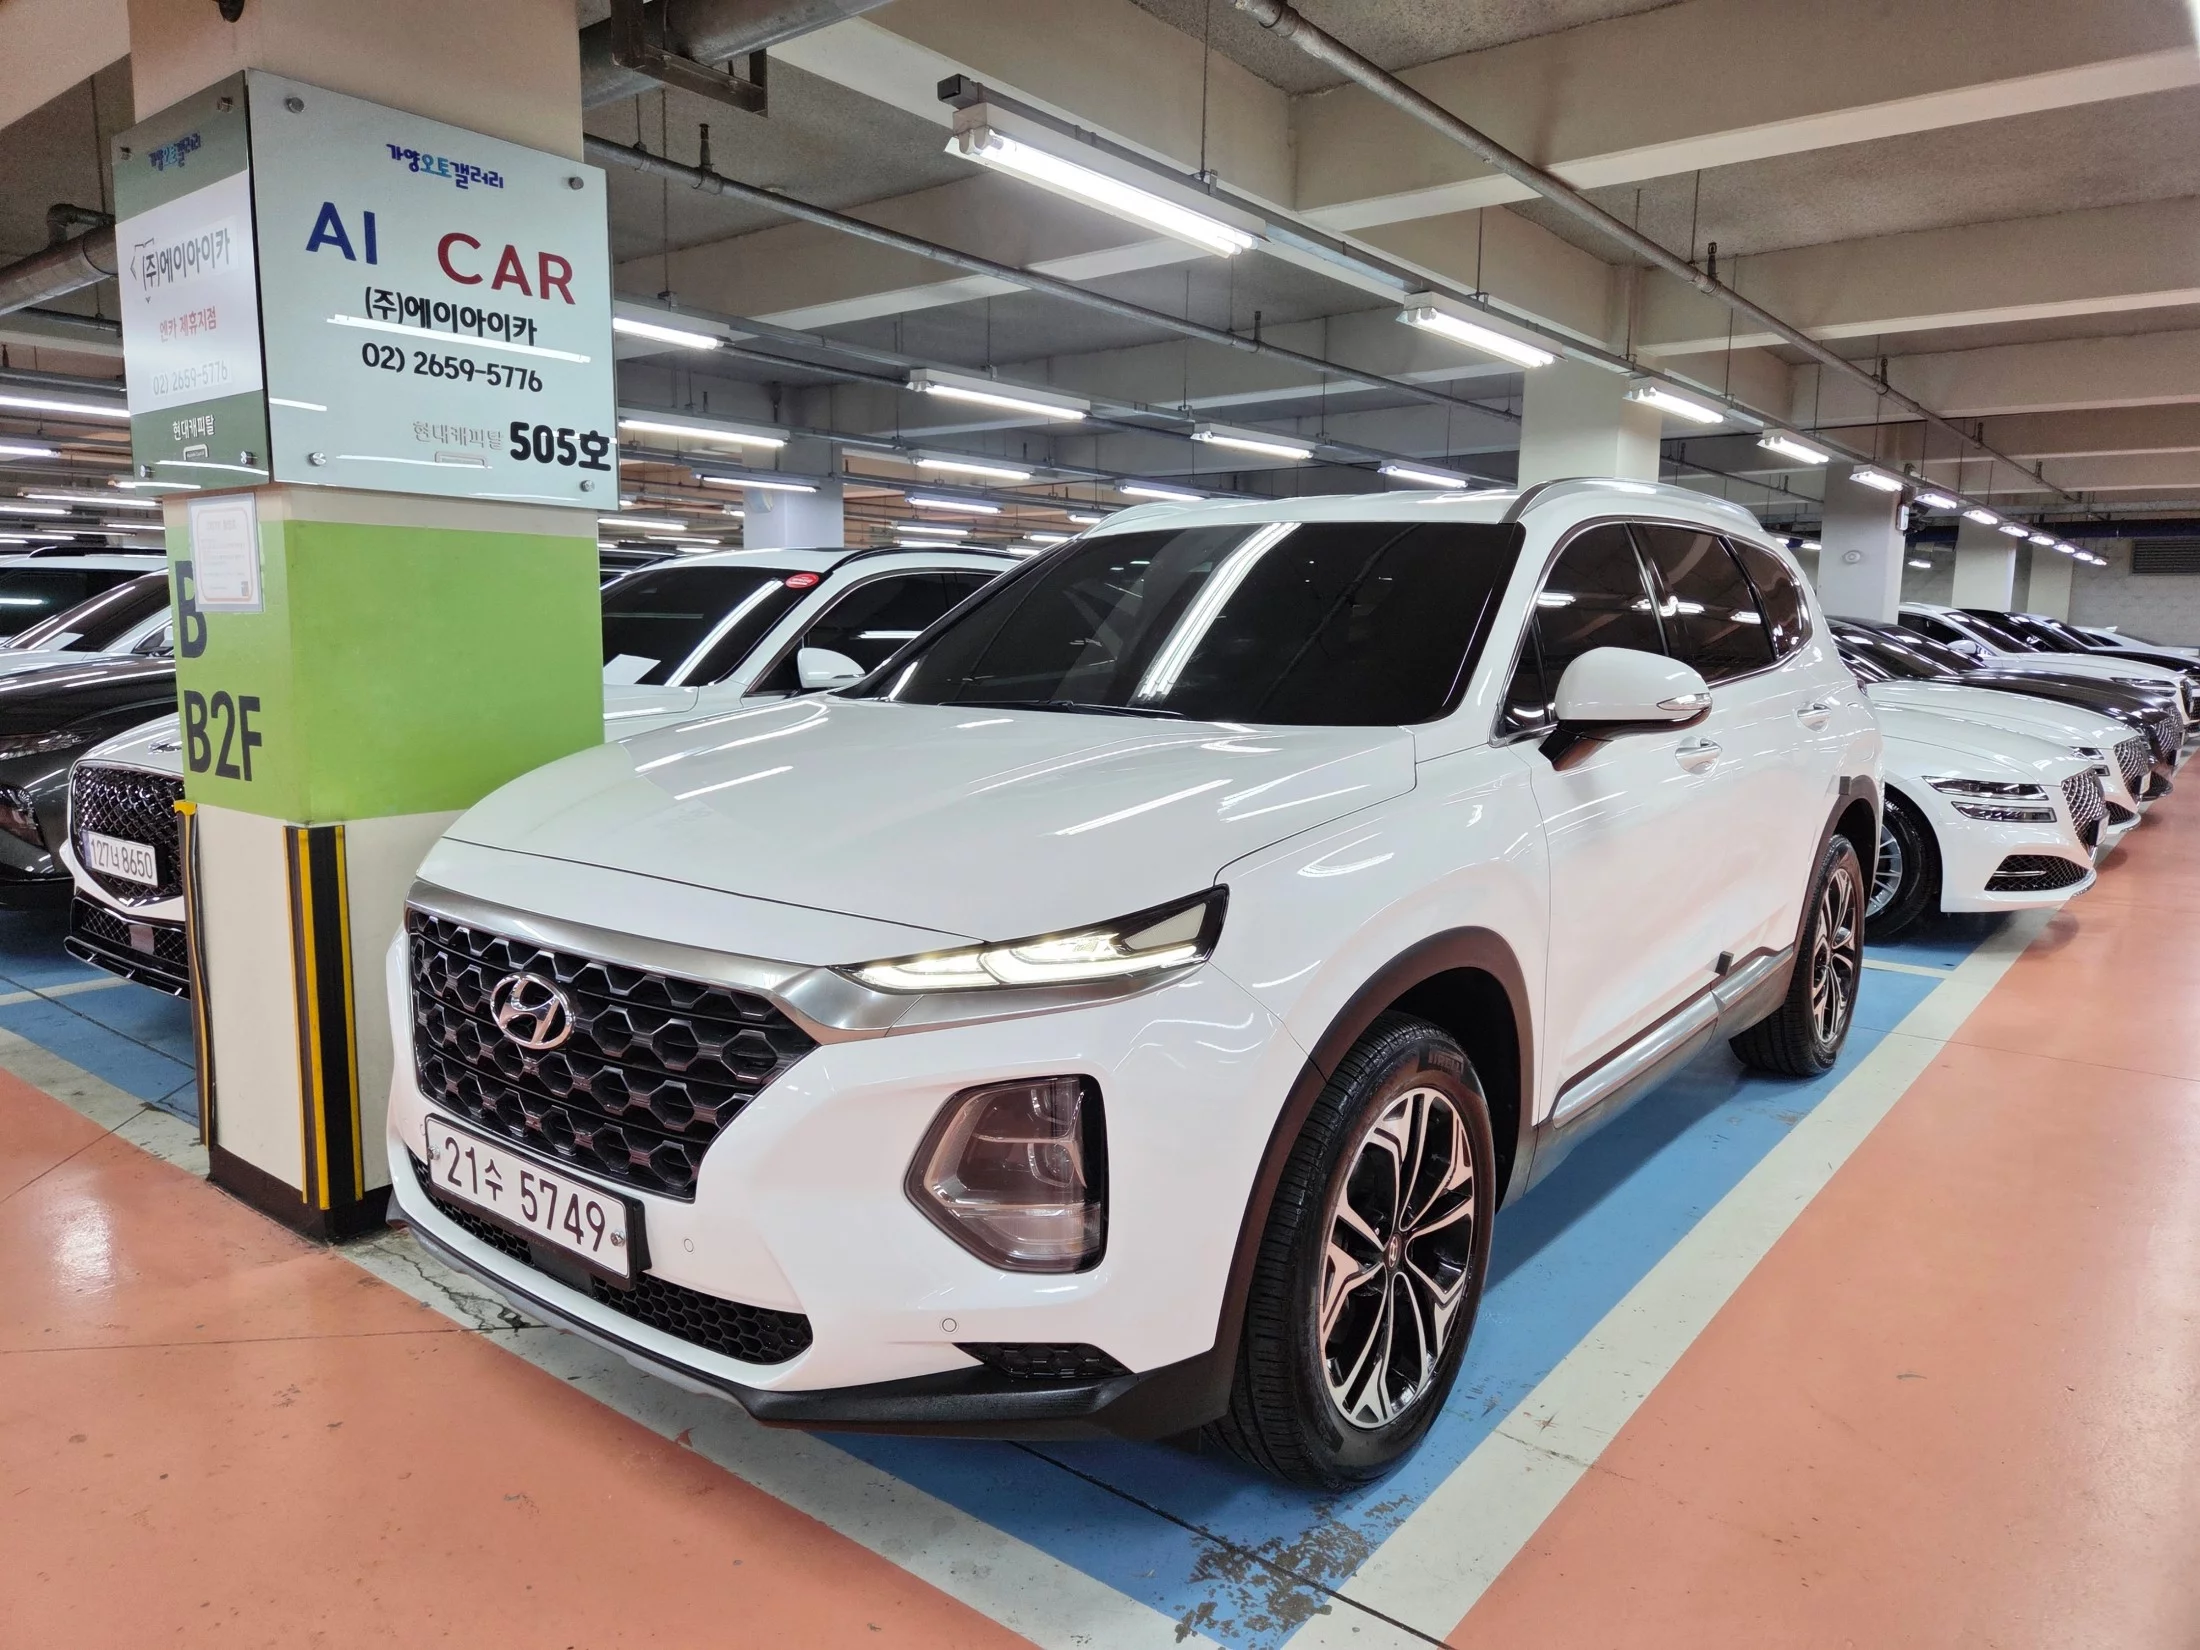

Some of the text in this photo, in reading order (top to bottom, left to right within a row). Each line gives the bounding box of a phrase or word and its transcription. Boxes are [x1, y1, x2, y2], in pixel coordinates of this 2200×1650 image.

[386, 143, 504, 189] 가양오토갤러리
[142, 228, 230, 291] (주)에이아이카
[305, 201, 576, 305] AI CAR
[159, 306, 217, 343] 엔카 제휴지점
[364, 286, 538, 347] (주)에이아이카
[153, 360, 228, 395] 02) 2659-5776
[361, 342, 543, 393] 02) 2659-5776
[172, 414, 215, 441] 현대캐피탈
[509, 421, 612, 472] 505호
[175, 560, 208, 659] B
[183, 689, 263, 782] B2F
[121, 846, 153, 879] 8650
[445, 1136, 606, 1253] 21수 5749
